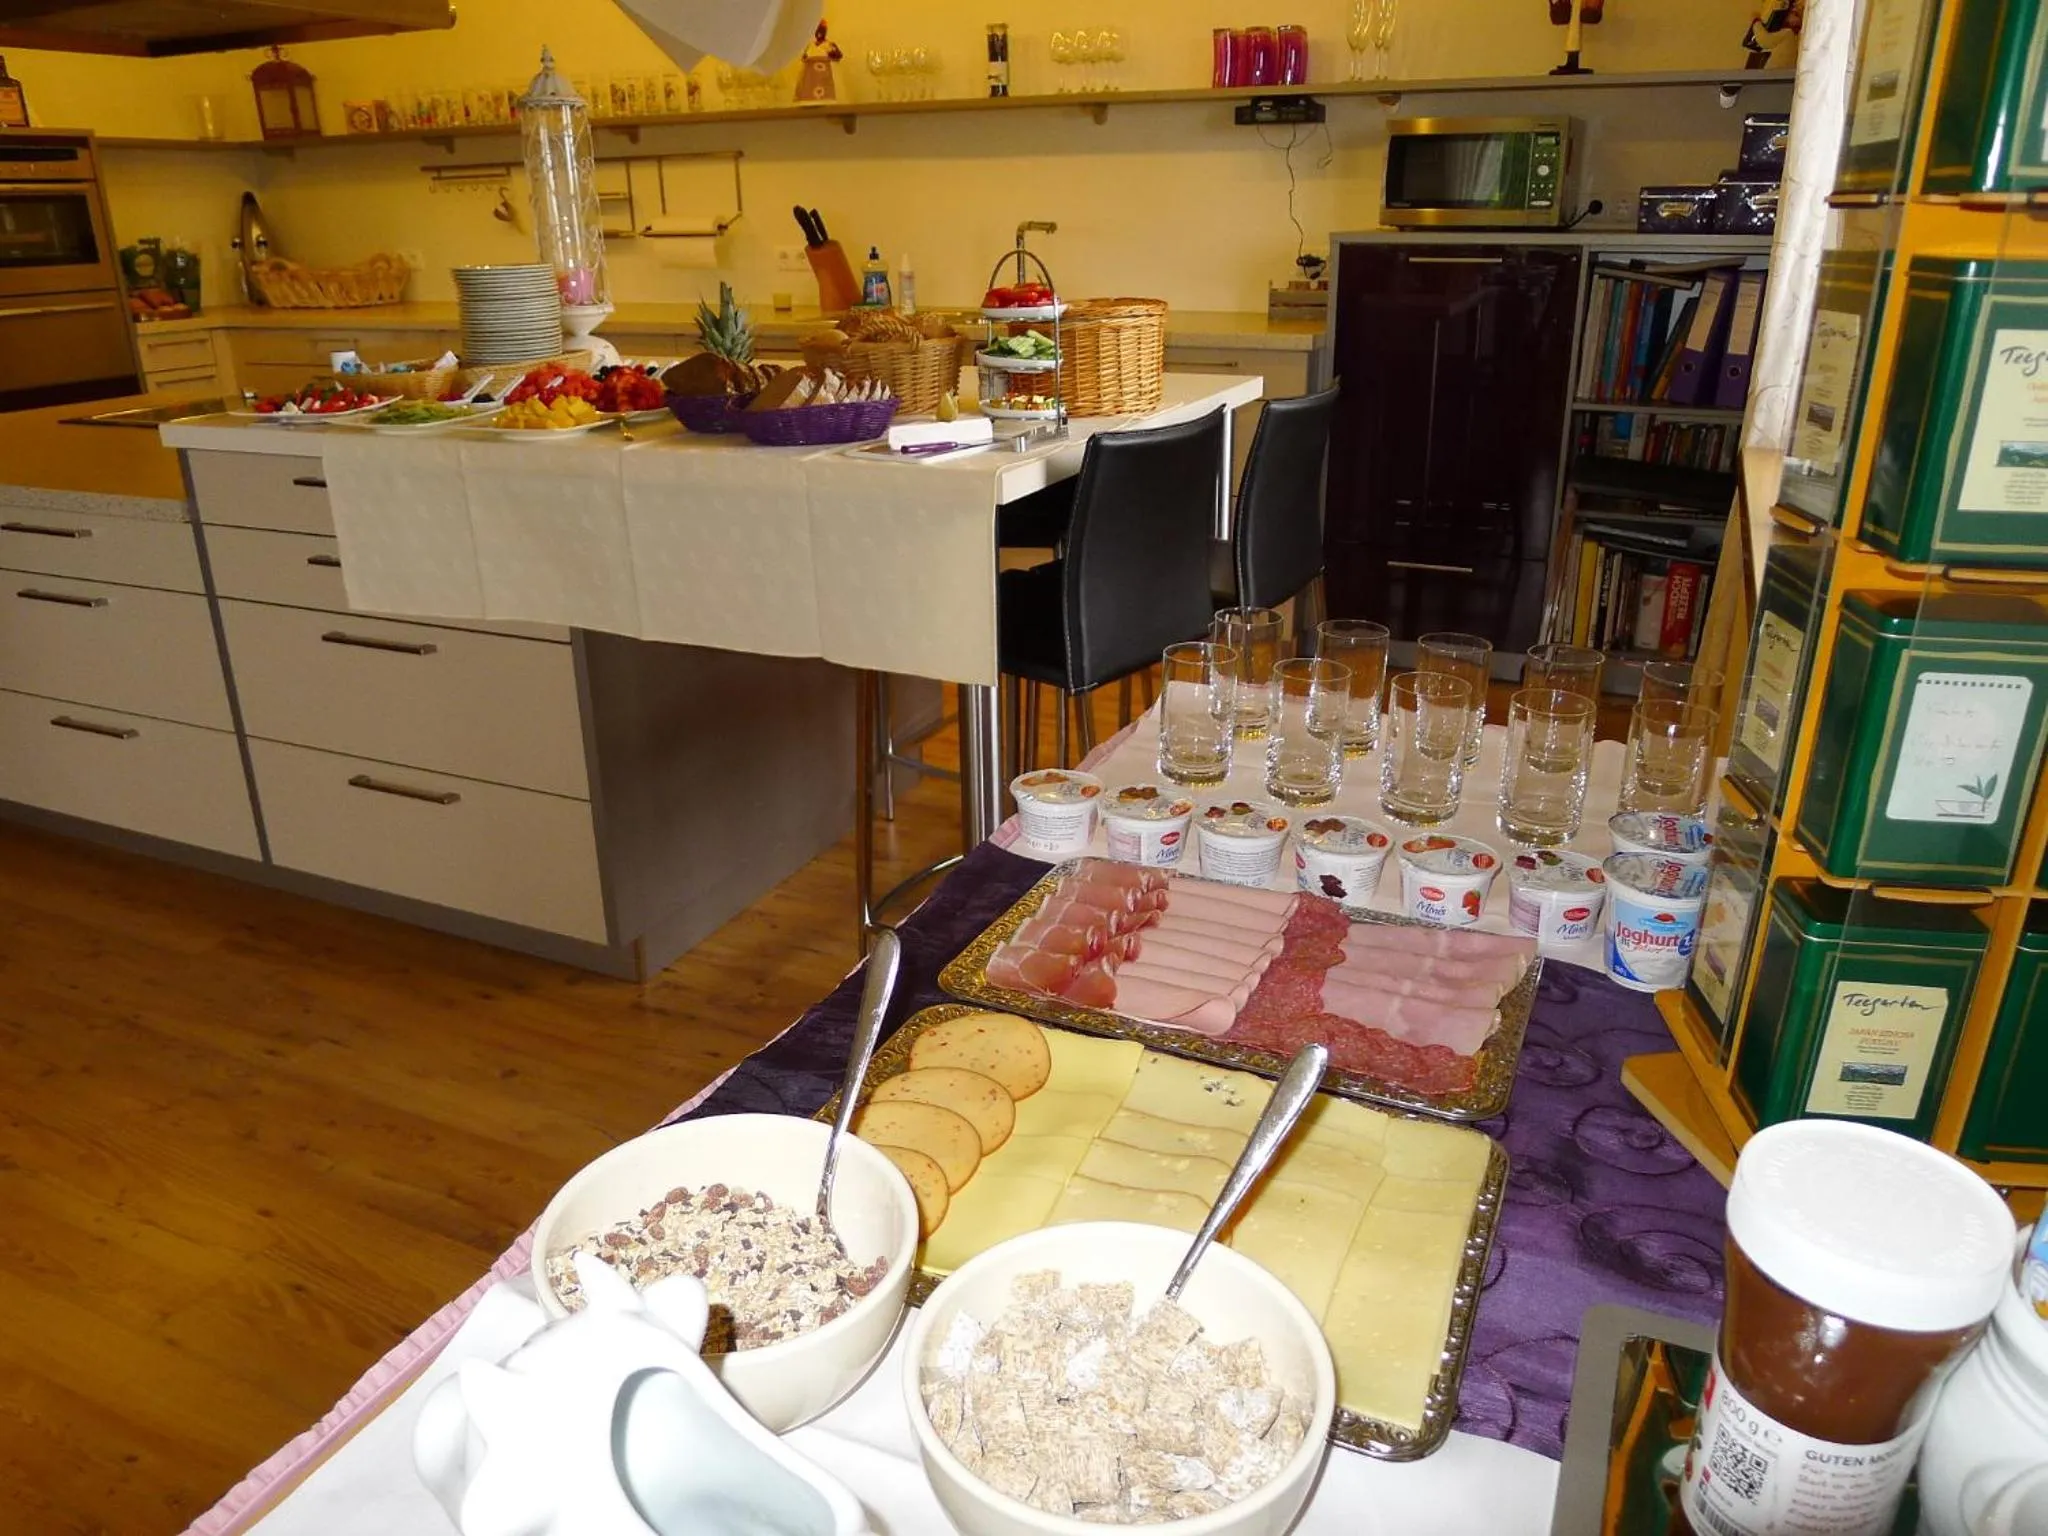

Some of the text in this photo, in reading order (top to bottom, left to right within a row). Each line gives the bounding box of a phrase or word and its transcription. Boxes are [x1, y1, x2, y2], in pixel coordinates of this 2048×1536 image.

[1999, 345, 2048, 377] Teeg
[1616, 920, 1680, 947] Joghurt
[1843, 993, 1944, 1016] Teegarten
[1805, 1449, 1864, 1466] GUTEN
